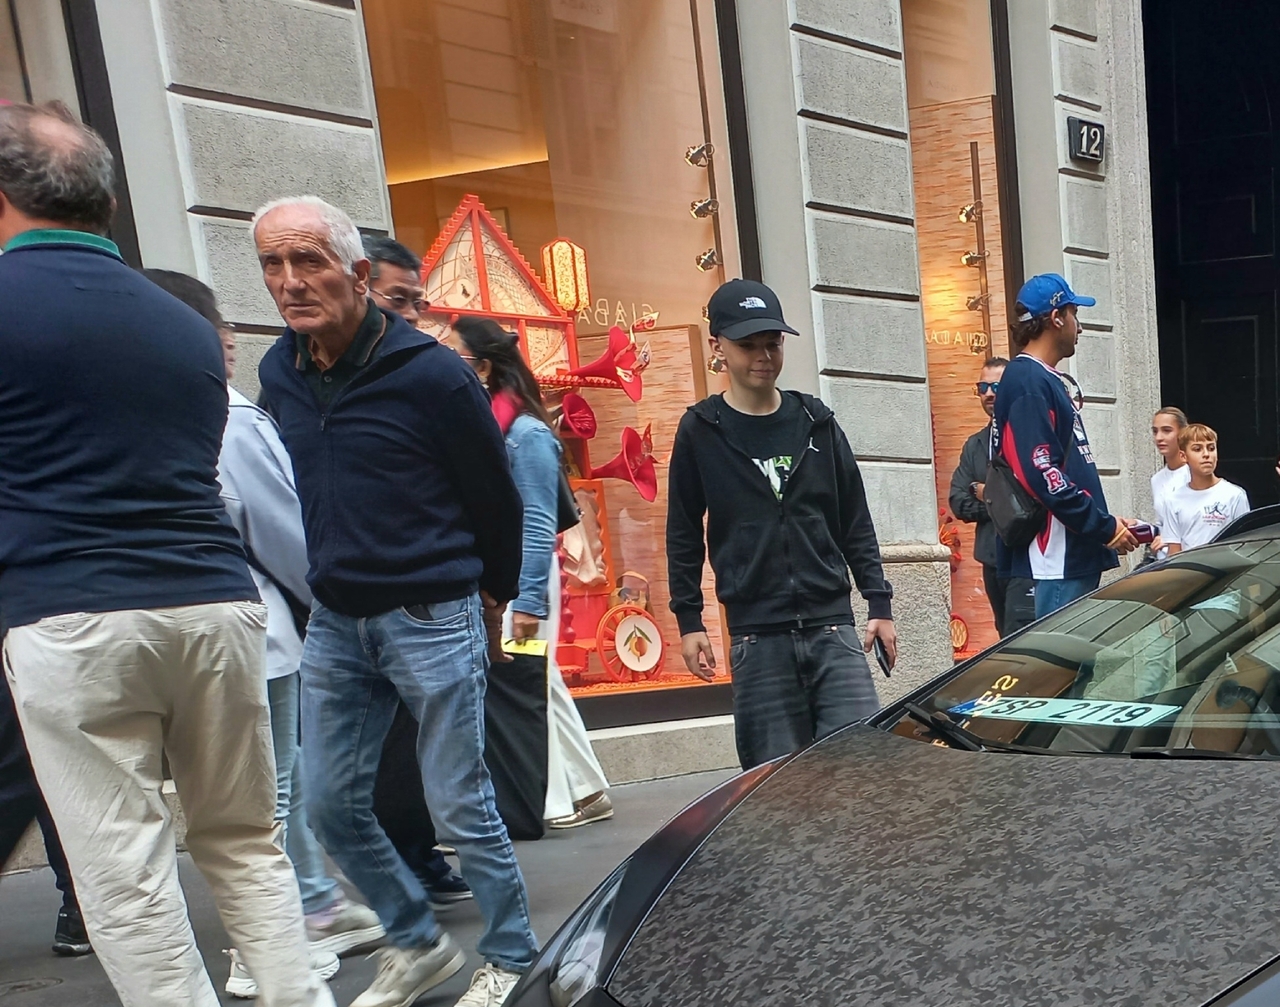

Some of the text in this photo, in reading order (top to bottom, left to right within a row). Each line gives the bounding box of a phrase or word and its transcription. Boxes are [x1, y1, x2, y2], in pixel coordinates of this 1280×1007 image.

[1080, 125, 1100, 156] 12
[1043, 467, 1067, 494] R
[1048, 702, 1152, 724] 2119
